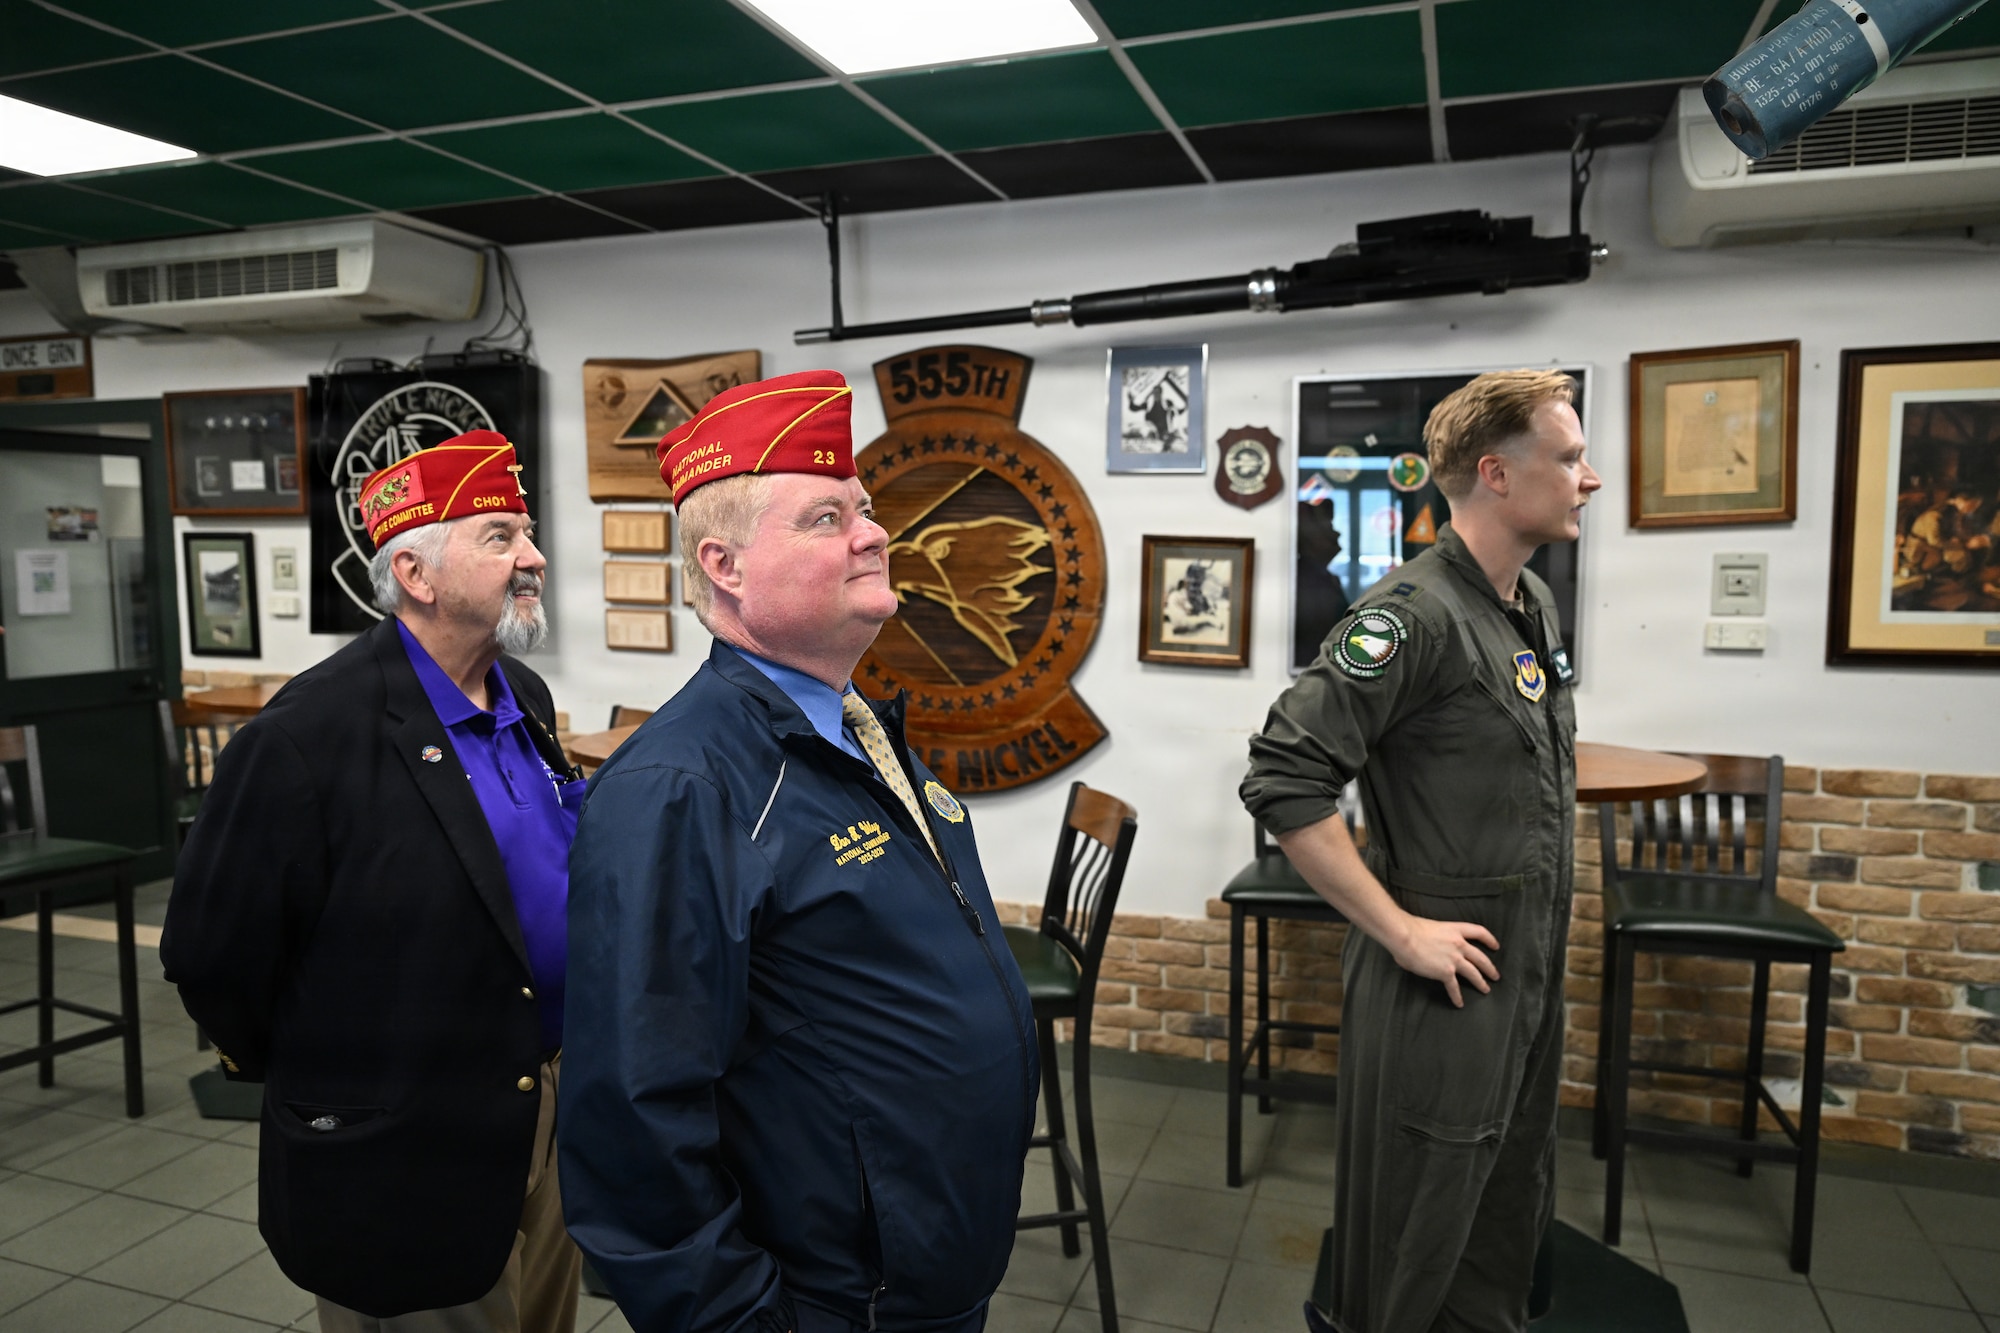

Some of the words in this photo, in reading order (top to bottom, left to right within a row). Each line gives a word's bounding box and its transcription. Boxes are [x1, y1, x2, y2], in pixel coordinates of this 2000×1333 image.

[1767, 6, 1829, 53] PRACICAS
[890, 352, 1010, 404] 555TH
[356, 387, 423, 446] TRIPLE
[672, 441, 724, 480] NATIONAL
[813, 450, 836, 465] 23
[388, 503, 435, 529] COMMITTEE
[1349, 666, 1376, 677] NICKEL
[957, 722, 1077, 788] NICKEL
[835, 846, 865, 866] NATIONAL
[862, 832, 891, 851] COMMANDER
